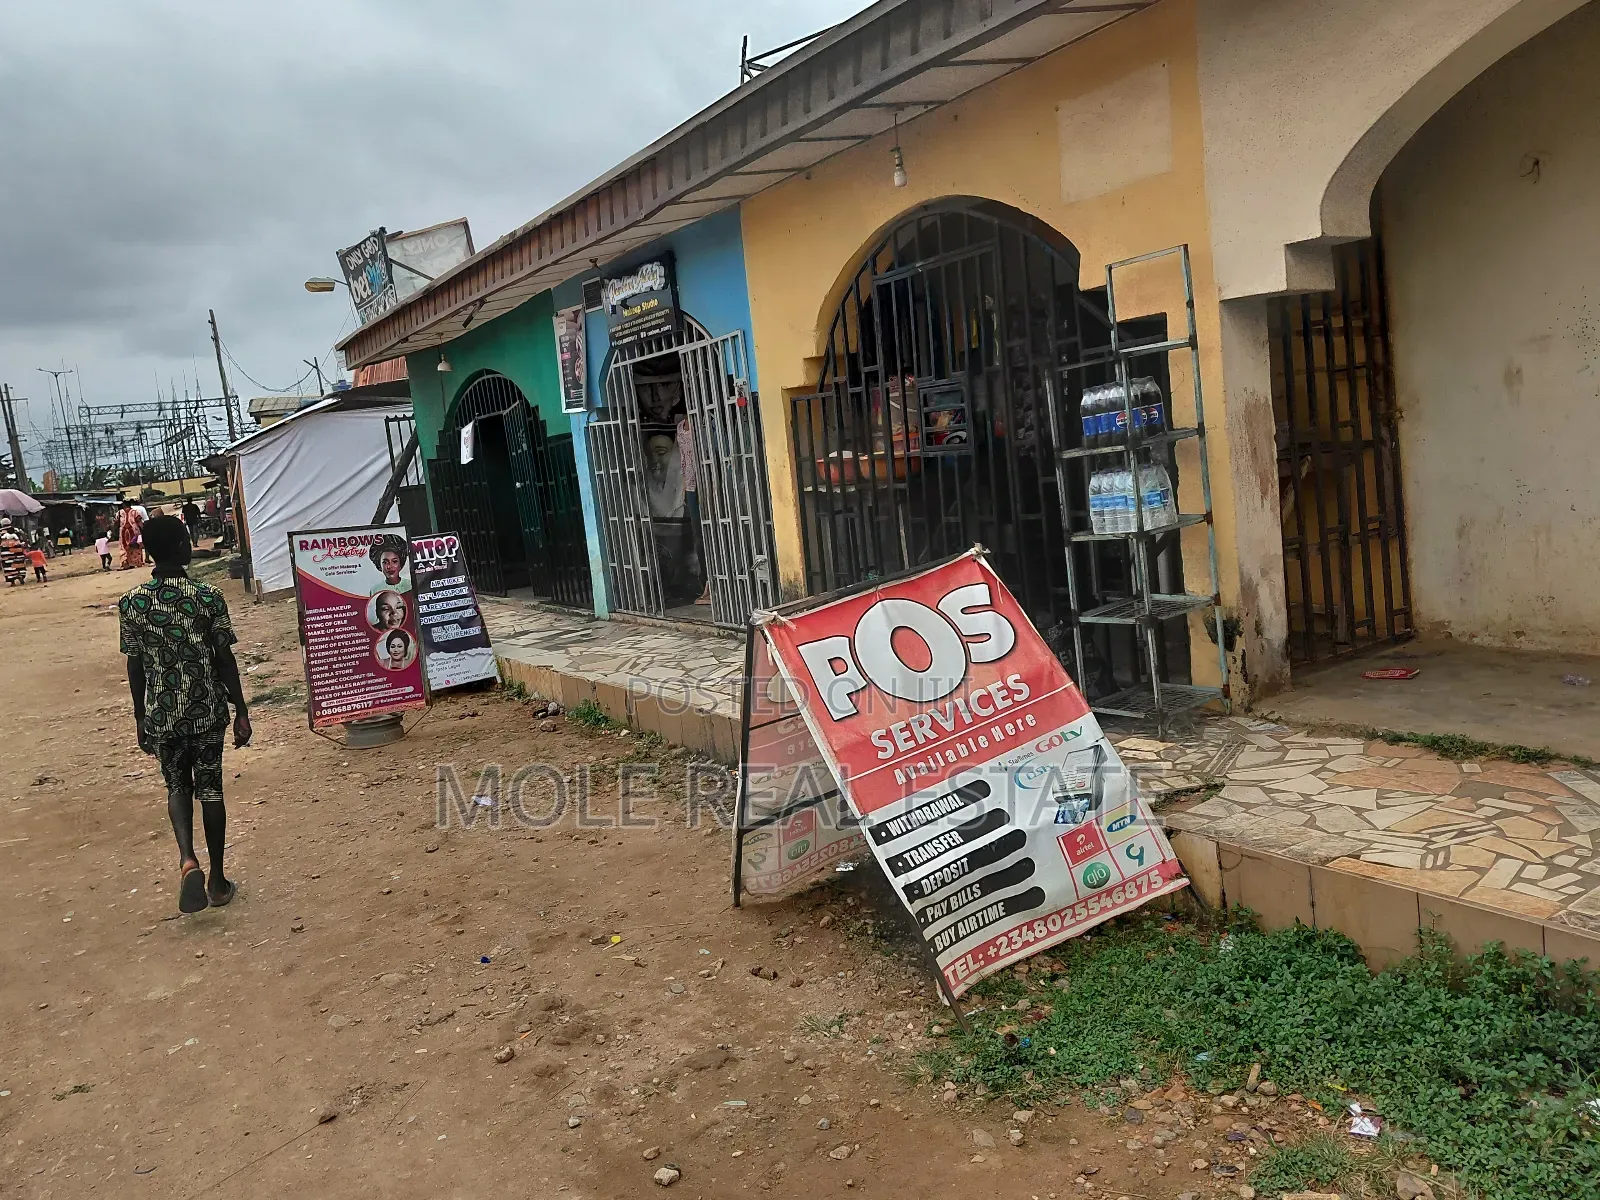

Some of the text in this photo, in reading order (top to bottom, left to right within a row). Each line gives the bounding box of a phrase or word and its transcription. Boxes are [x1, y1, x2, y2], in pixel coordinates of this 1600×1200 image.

[345, 247, 364, 271] ONLY
[361, 236, 379, 258] GOD
[641, 298, 659, 310] Studio
[298, 533, 384, 551] RAINBOWS
[312, 544, 368, 564] Artistry
[443, 575, 466, 586] TICKET
[437, 586, 469, 598] PASSPORT
[430, 597, 474, 610] RESERVATION
[461, 608, 477, 618] VISA
[431, 623, 462, 635] ALL VISA
[432, 626, 481, 642] PROCUREMENT
[338, 638, 370, 647] EYELASHES
[340, 645, 370, 653] GROOMING
[797, 583, 1016, 721] POS
[339, 674, 365, 682] COCONUT
[314, 682, 352, 694] WHOLESALES
[342, 688, 365, 696] MAKEUP
[366, 683, 392, 691] PRODUCT
[322, 701, 373, 716] 08068876117
[870, 673, 1031, 760] SERVICES
[893, 712, 1038, 786] Available Here
[886, 793, 965, 837] WITHDRAWAL
[1112, 816, 1131, 832] MTN
[902, 830, 964, 868] TRANSFER
[1076, 842, 1095, 856] airtel
[920, 857, 970, 896] DEPOSIT
[1086, 866, 1106, 886] glo
[926, 883, 982, 923] PAY BILLS
[934, 902, 1006, 953] BUY AIRTIME
[944, 870, 1164, 987] TEL: +2348025546875
